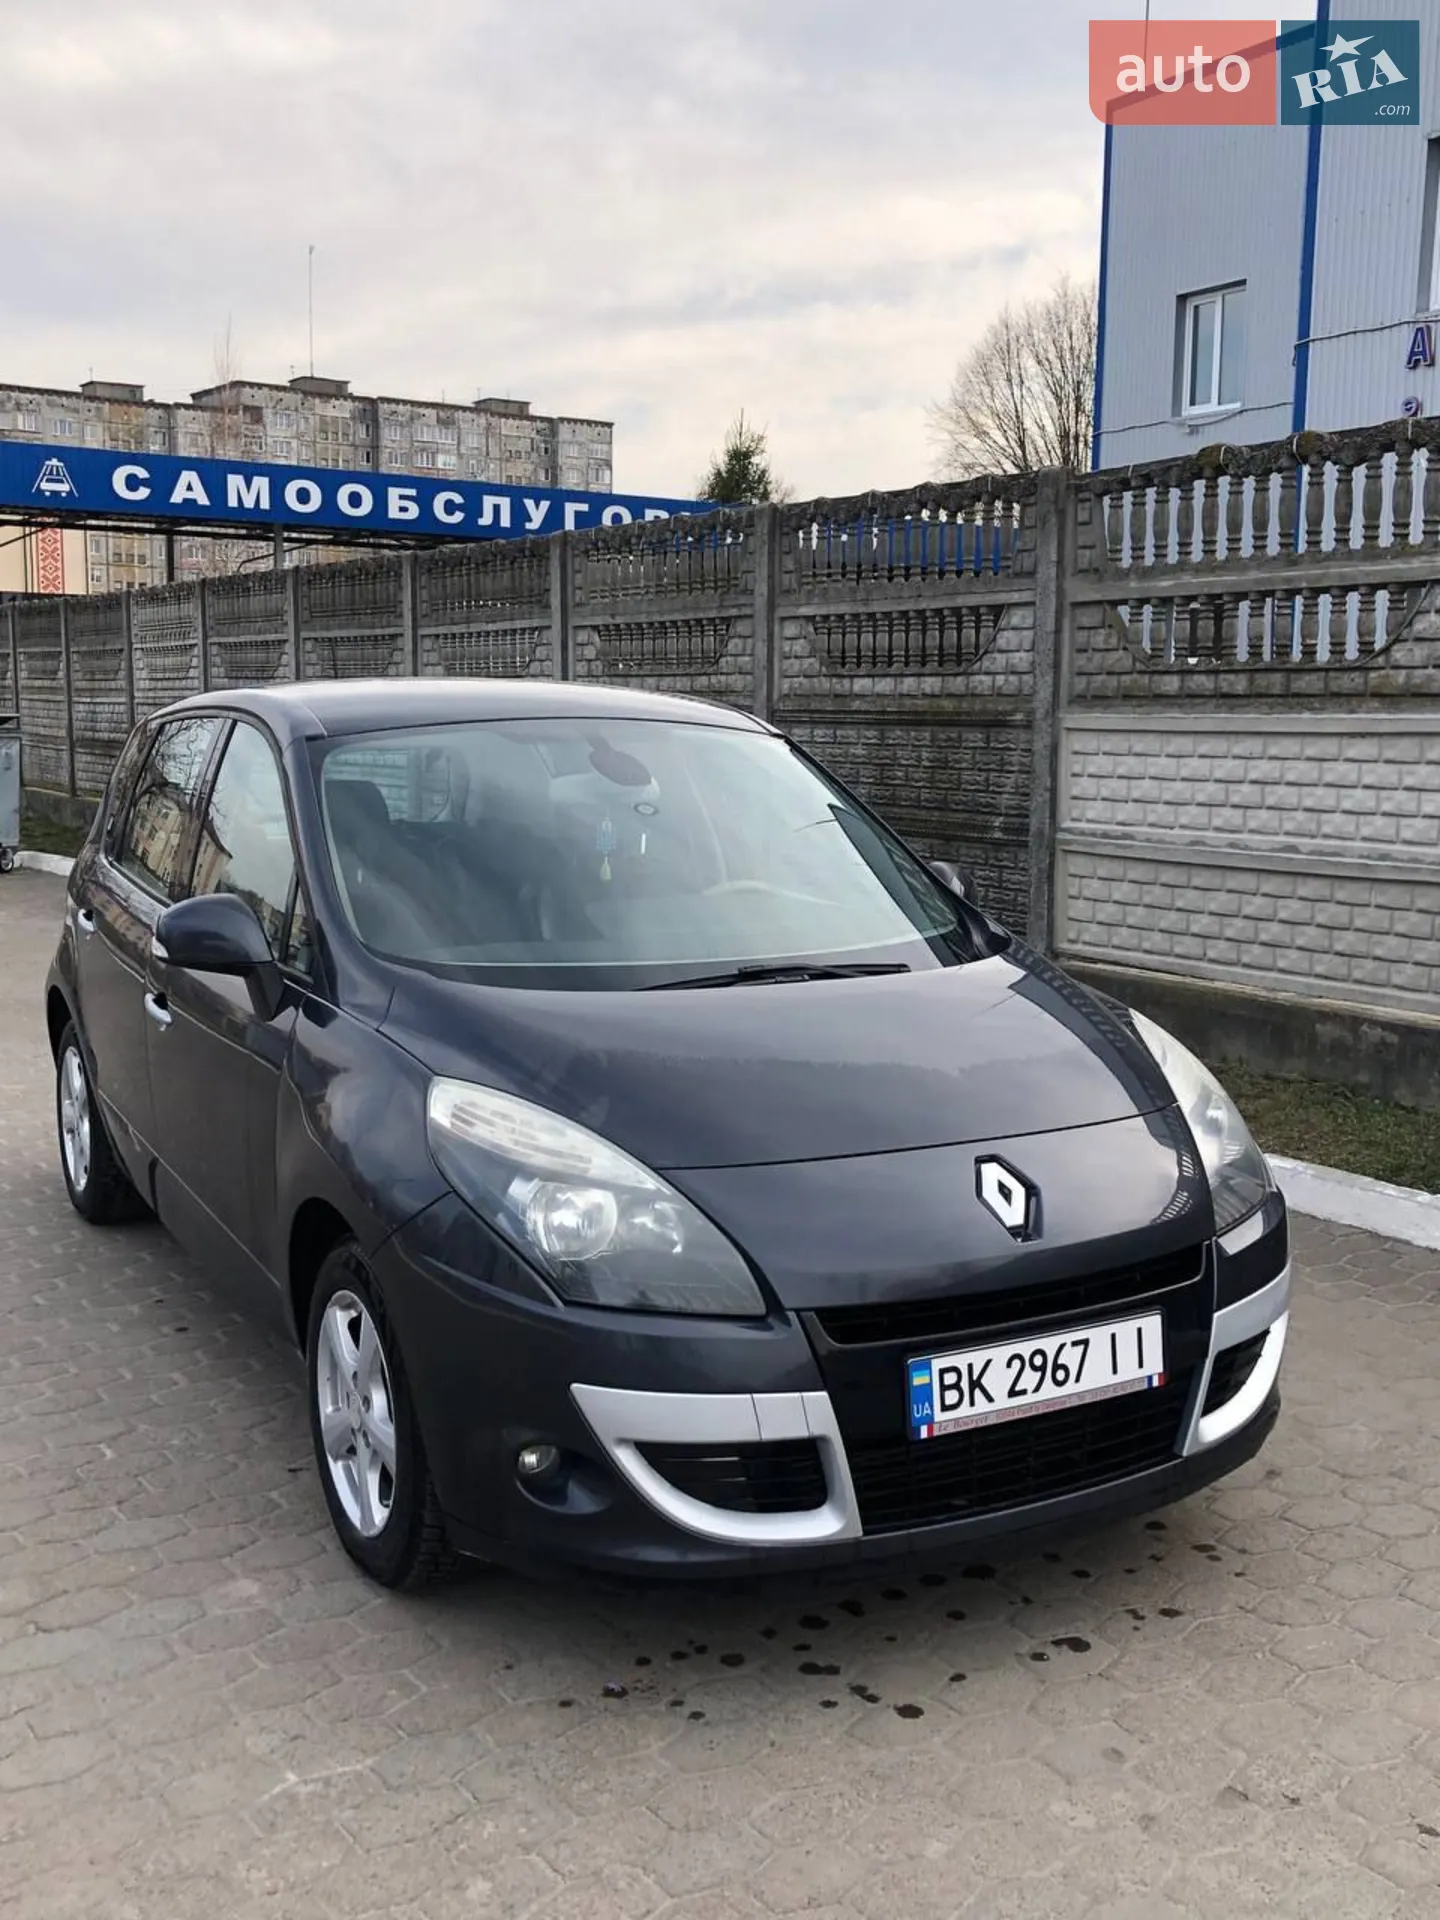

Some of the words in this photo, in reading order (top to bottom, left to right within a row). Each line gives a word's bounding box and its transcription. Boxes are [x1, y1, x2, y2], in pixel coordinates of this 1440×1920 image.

[111, 464, 691, 530] САМООБСЛУГО
[937, 1358, 995, 1413] BK
[1006, 1338, 1090, 1399] 2967
[913, 1402, 932, 1418] UA
